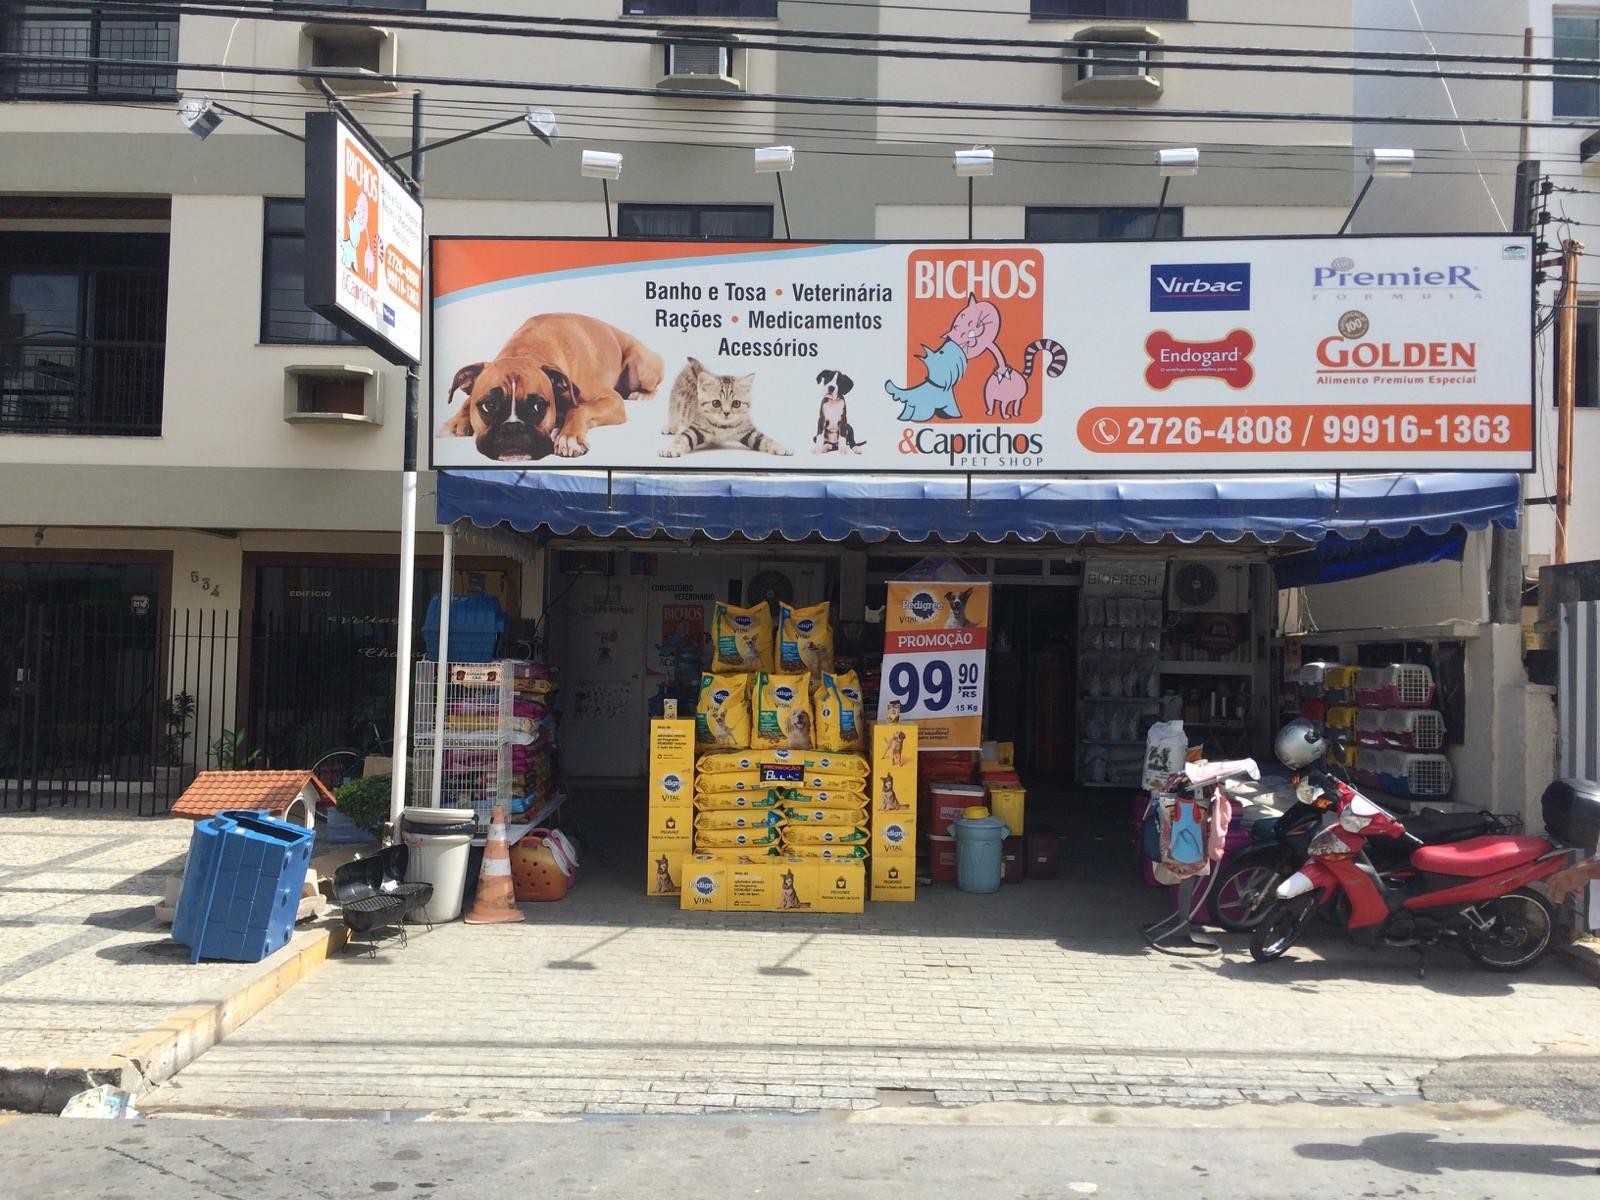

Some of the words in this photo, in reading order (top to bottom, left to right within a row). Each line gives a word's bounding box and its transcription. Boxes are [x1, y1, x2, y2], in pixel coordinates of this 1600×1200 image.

[345, 146, 379, 203] BICHOS
[914, 259, 1037, 299] BICHOS
[1157, 275, 1243, 293] Virbac
[645, 281, 702, 300] Banho
[708, 287, 719, 301] e
[725, 283, 766, 301] Tosa
[792, 283, 892, 302] Veterinária
[655, 309, 722, 333] Rações
[748, 311, 882, 330] Medicamentos
[718, 337, 819, 357] Acessórios
[1316, 336, 1477, 368] GOLDEN
[1160, 347, 1238, 367] Endogard
[1317, 376, 1369, 385] Alimento
[1373, 375, 1424, 384] Premium
[1429, 375, 1476, 386] Especial
[1127, 416, 1293, 445] 2726-4808
[1301, 415, 1313, 447] /
[1322, 415, 1511, 444] 99916-1363
[961, 457, 989, 466] PET
[999, 457, 1043, 466] SHOP
[190, 570, 220, 597] 534
[1087, 573, 1158, 586] BIOFRESH
[663, 607, 704, 620] BICHOS
[902, 600, 944, 611] Pedigree
[898, 630, 973, 649] PROMOÇÃO
[958, 663, 978, 685] 90
[967, 703, 978, 712] Kg
[688, 879, 721, 890] edigr
[694, 897, 713, 905] VITAL
